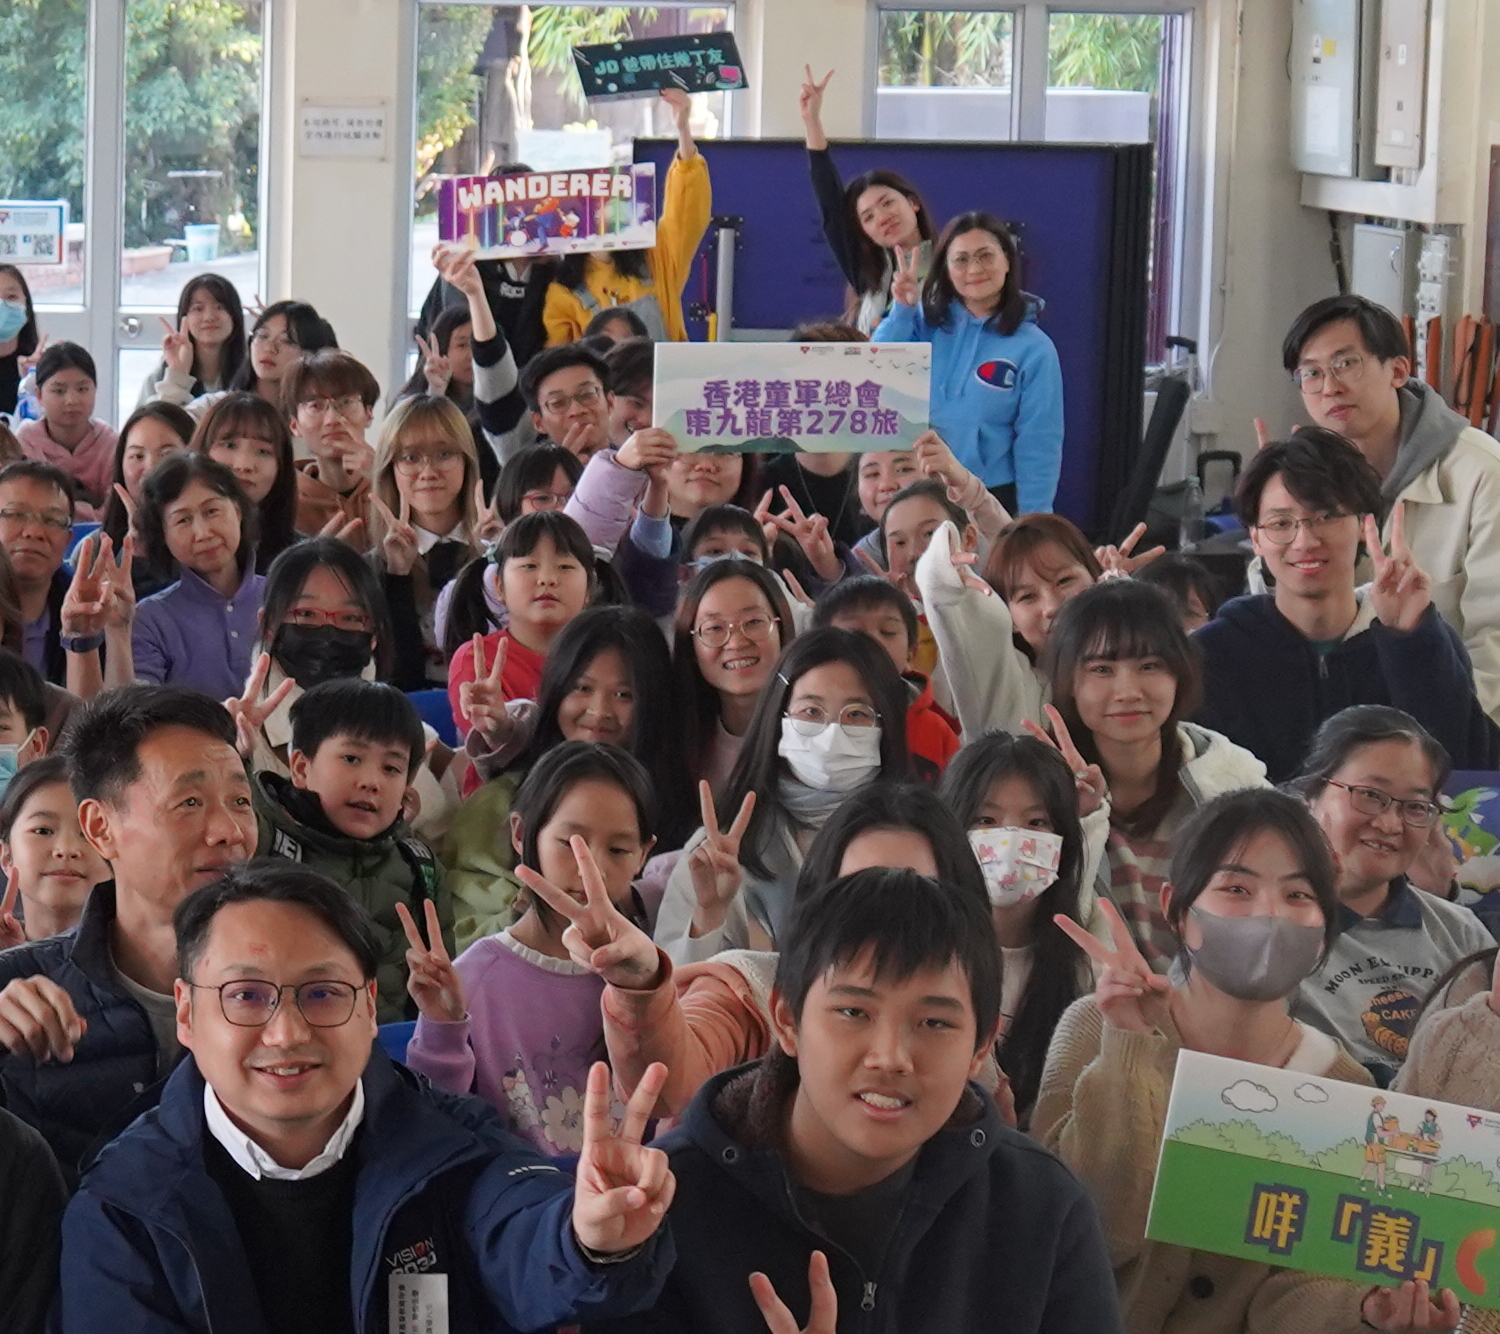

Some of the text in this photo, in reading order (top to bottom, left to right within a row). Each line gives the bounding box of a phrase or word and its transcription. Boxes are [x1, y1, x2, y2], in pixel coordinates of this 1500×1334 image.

[457, 173, 632, 208] WANDERER
[702, 379, 883, 408] 香港童軍總會
[685, 408, 899, 437] 東九龍第278旅
[1324, 962, 1363, 995] MOON
[385, 1236, 436, 1268] VISION
